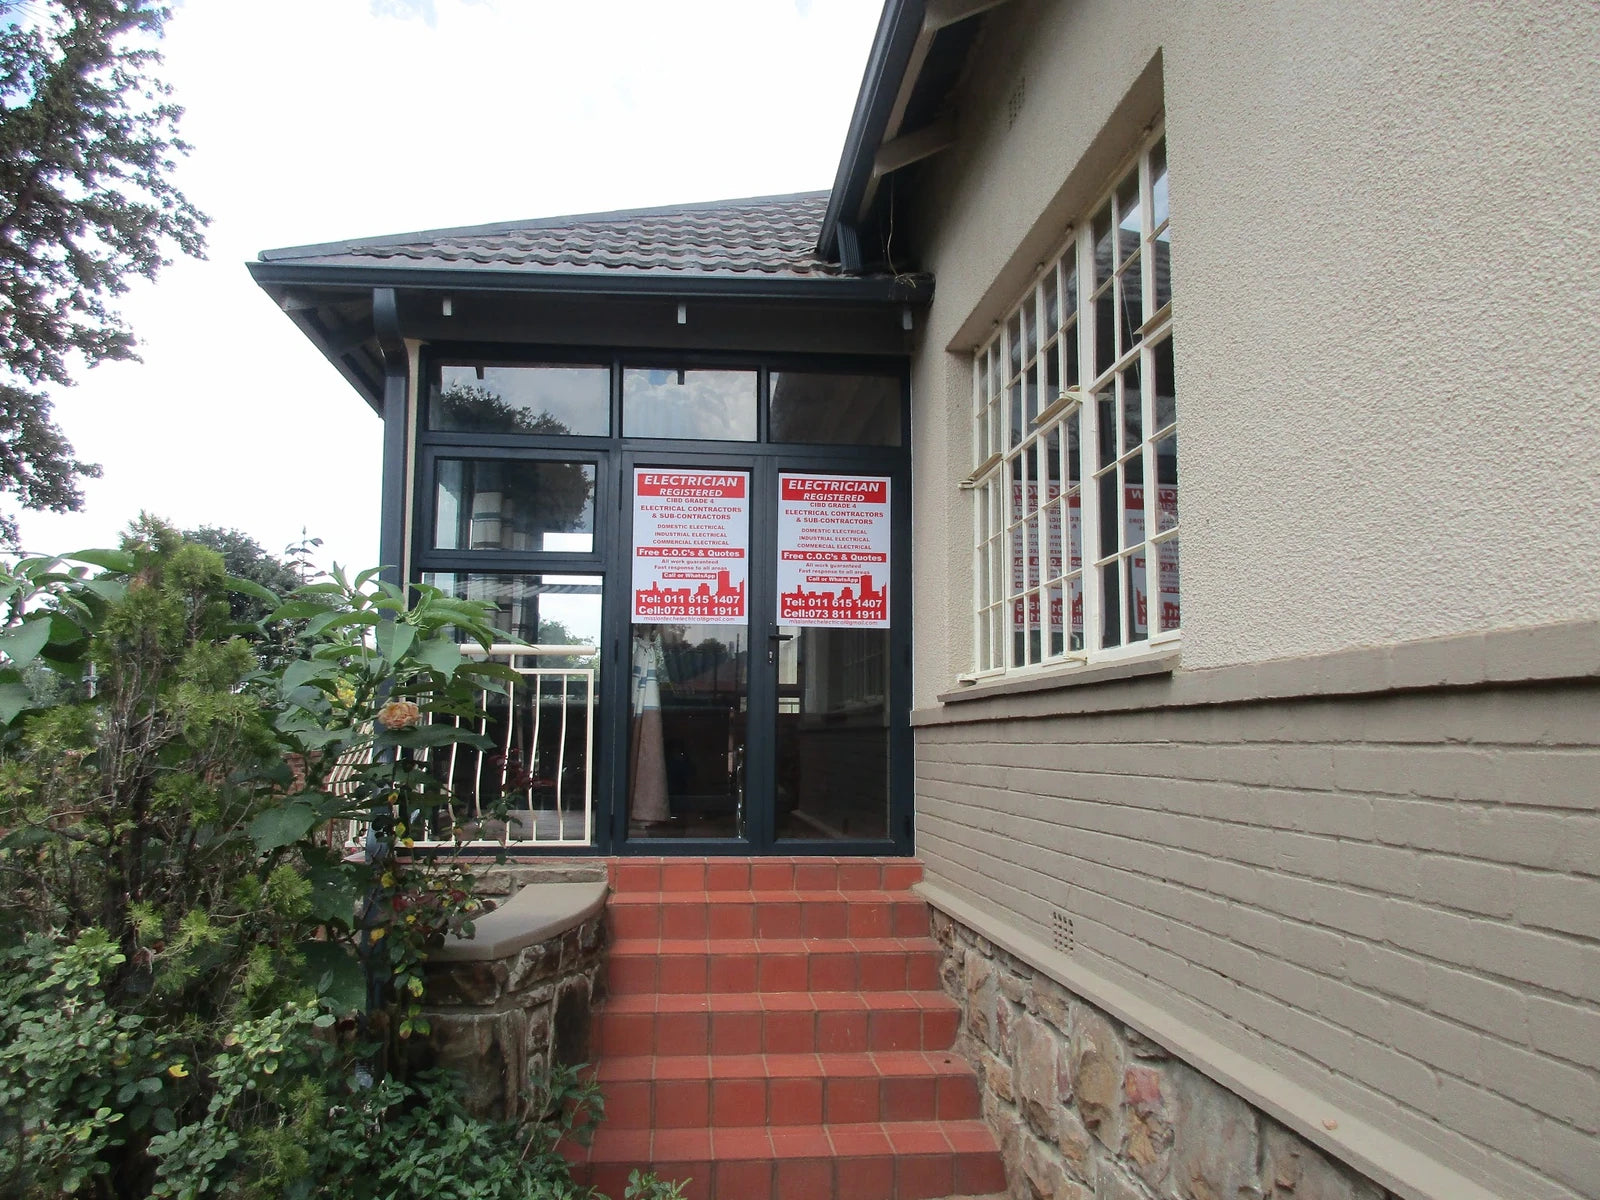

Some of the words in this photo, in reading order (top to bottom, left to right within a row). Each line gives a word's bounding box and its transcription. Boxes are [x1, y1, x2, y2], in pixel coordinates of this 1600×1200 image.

[644, 476, 737, 487] ELECTRICIAN
[789, 480, 879, 492] ELECTRICIAN
[660, 488, 723, 497] REGISTERED
[785, 598, 805, 606] Tel:
[832, 610, 851, 618] 811
